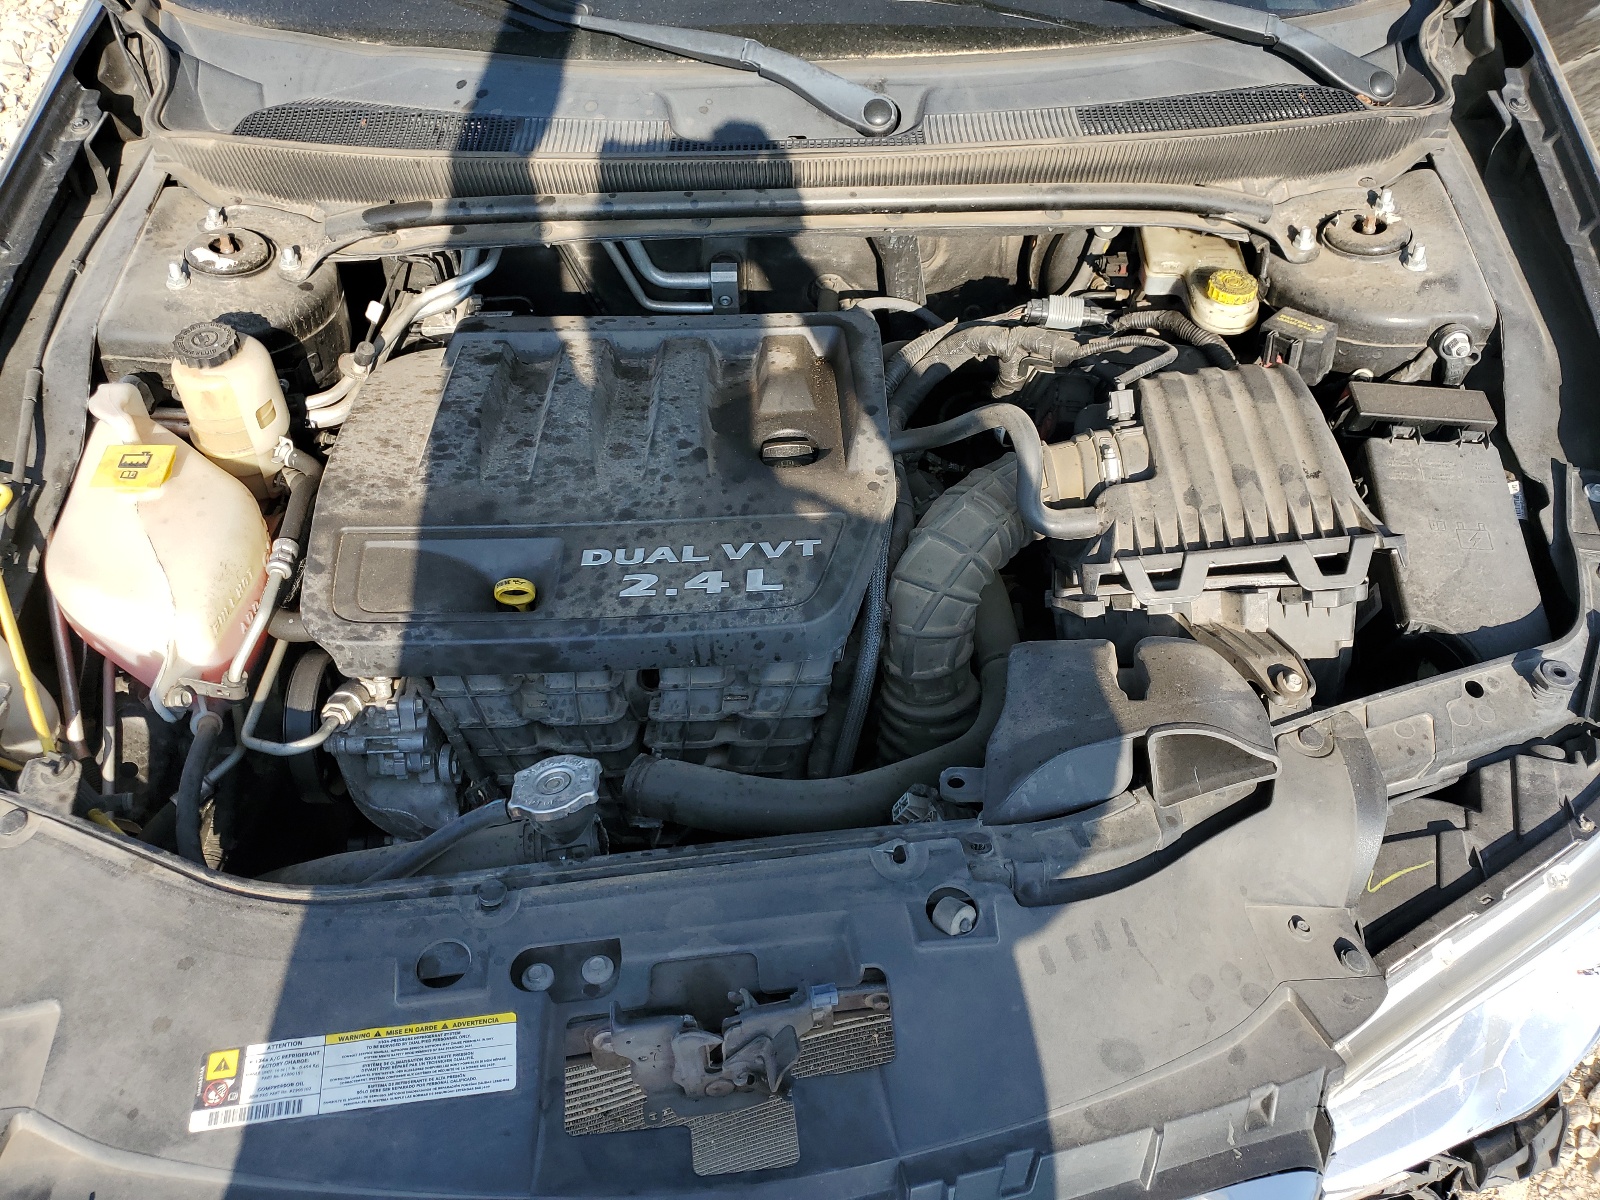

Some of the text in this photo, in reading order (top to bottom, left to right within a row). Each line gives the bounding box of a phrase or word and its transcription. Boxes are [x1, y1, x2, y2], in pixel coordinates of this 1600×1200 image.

[581, 539, 822, 566] DUAL VVT
[619, 568, 784, 597] 2.4 L
[338, 1033, 370, 1041] WARNING
[452, 1017, 498, 1027] ADVERTENCIA
[266, 1040, 302, 1050] ATTENTION
[281, 1050, 320, 1059] REFRIGERANT
[258, 1061, 283, 1069] FACTORY
